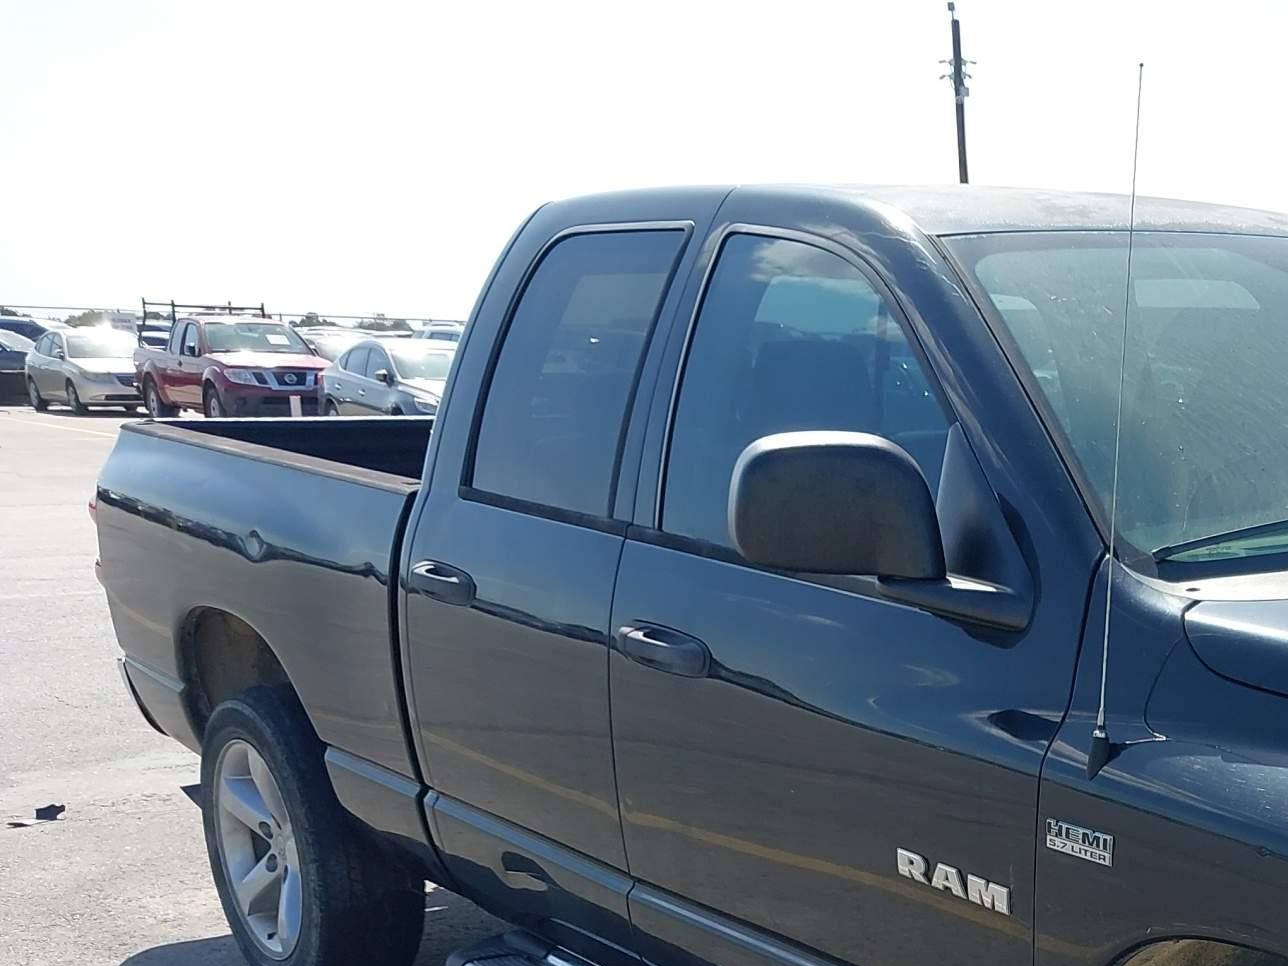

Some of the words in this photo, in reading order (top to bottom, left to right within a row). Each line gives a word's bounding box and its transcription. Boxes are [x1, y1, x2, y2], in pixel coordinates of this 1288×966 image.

[1046, 818, 1113, 853] HEMI
[1047, 838, 1068, 850] 5.7
[1070, 844, 1107, 864] LITER
[896, 847, 1011, 916] RAM
